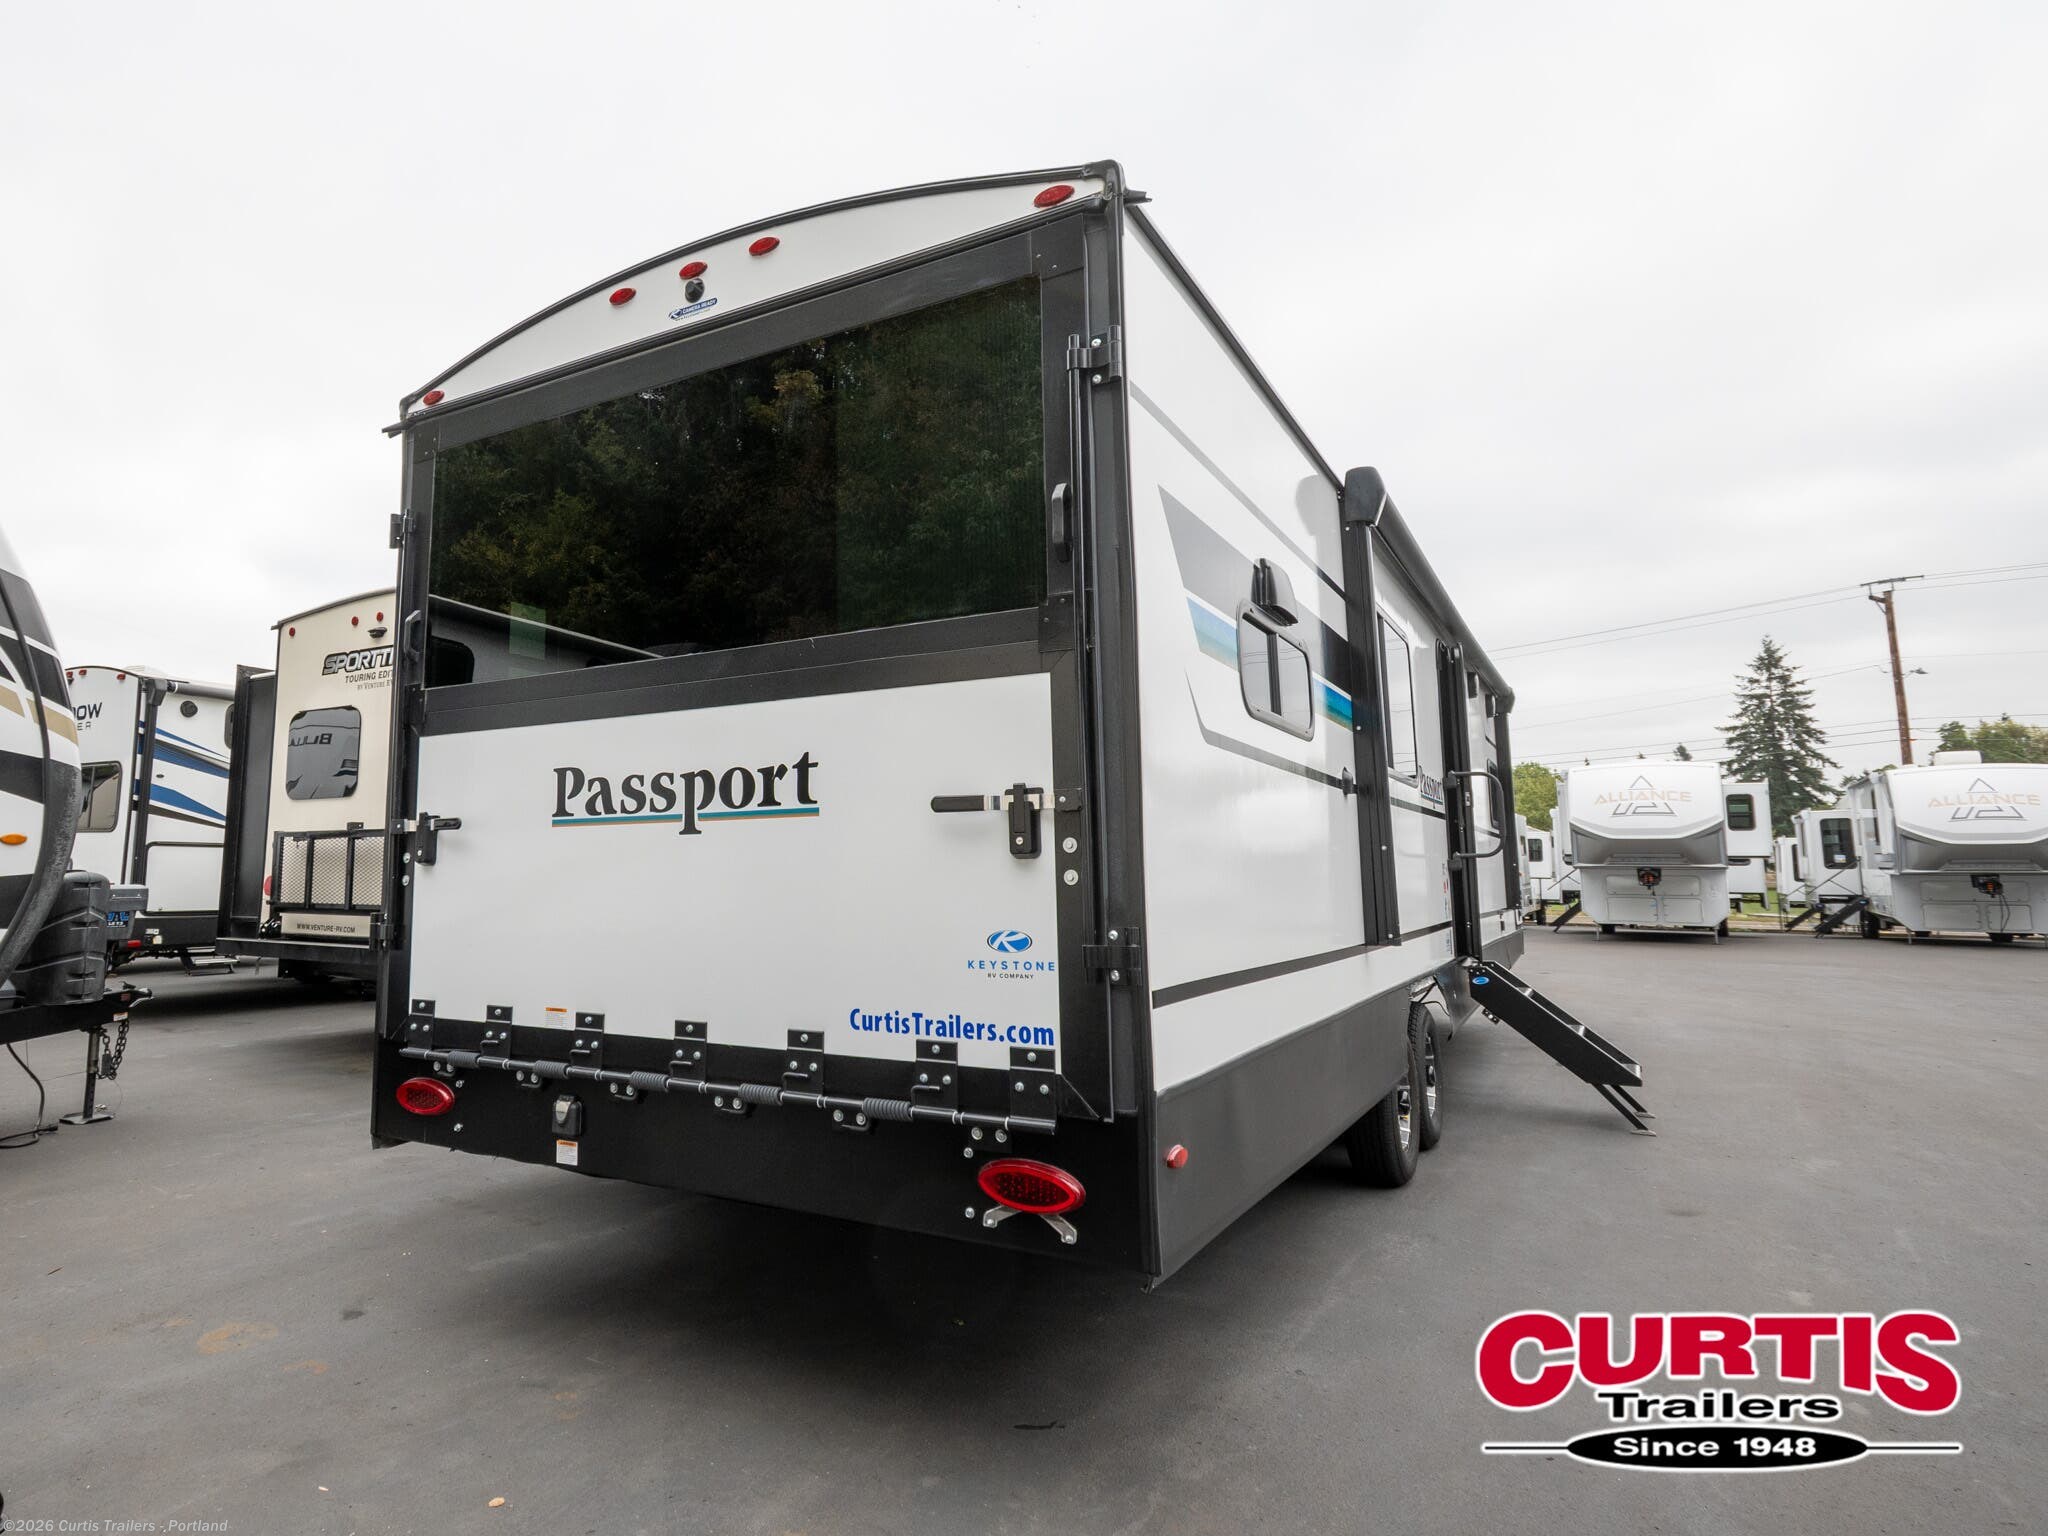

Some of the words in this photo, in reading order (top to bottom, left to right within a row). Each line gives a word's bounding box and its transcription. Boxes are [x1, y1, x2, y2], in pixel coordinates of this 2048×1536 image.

[345, 672, 376, 683] TOURING
[552, 752, 819, 835] Passport
[1594, 790, 1693, 805] ALLIANCE
[1928, 793, 2041, 808] ALLIANCE
[296, 923, 356, 933] WWW.VENTURE-RV.COM
[967, 960, 1056, 971] KEYSTONE
[850, 1008, 1055, 1046] CurtisTrailers.com
